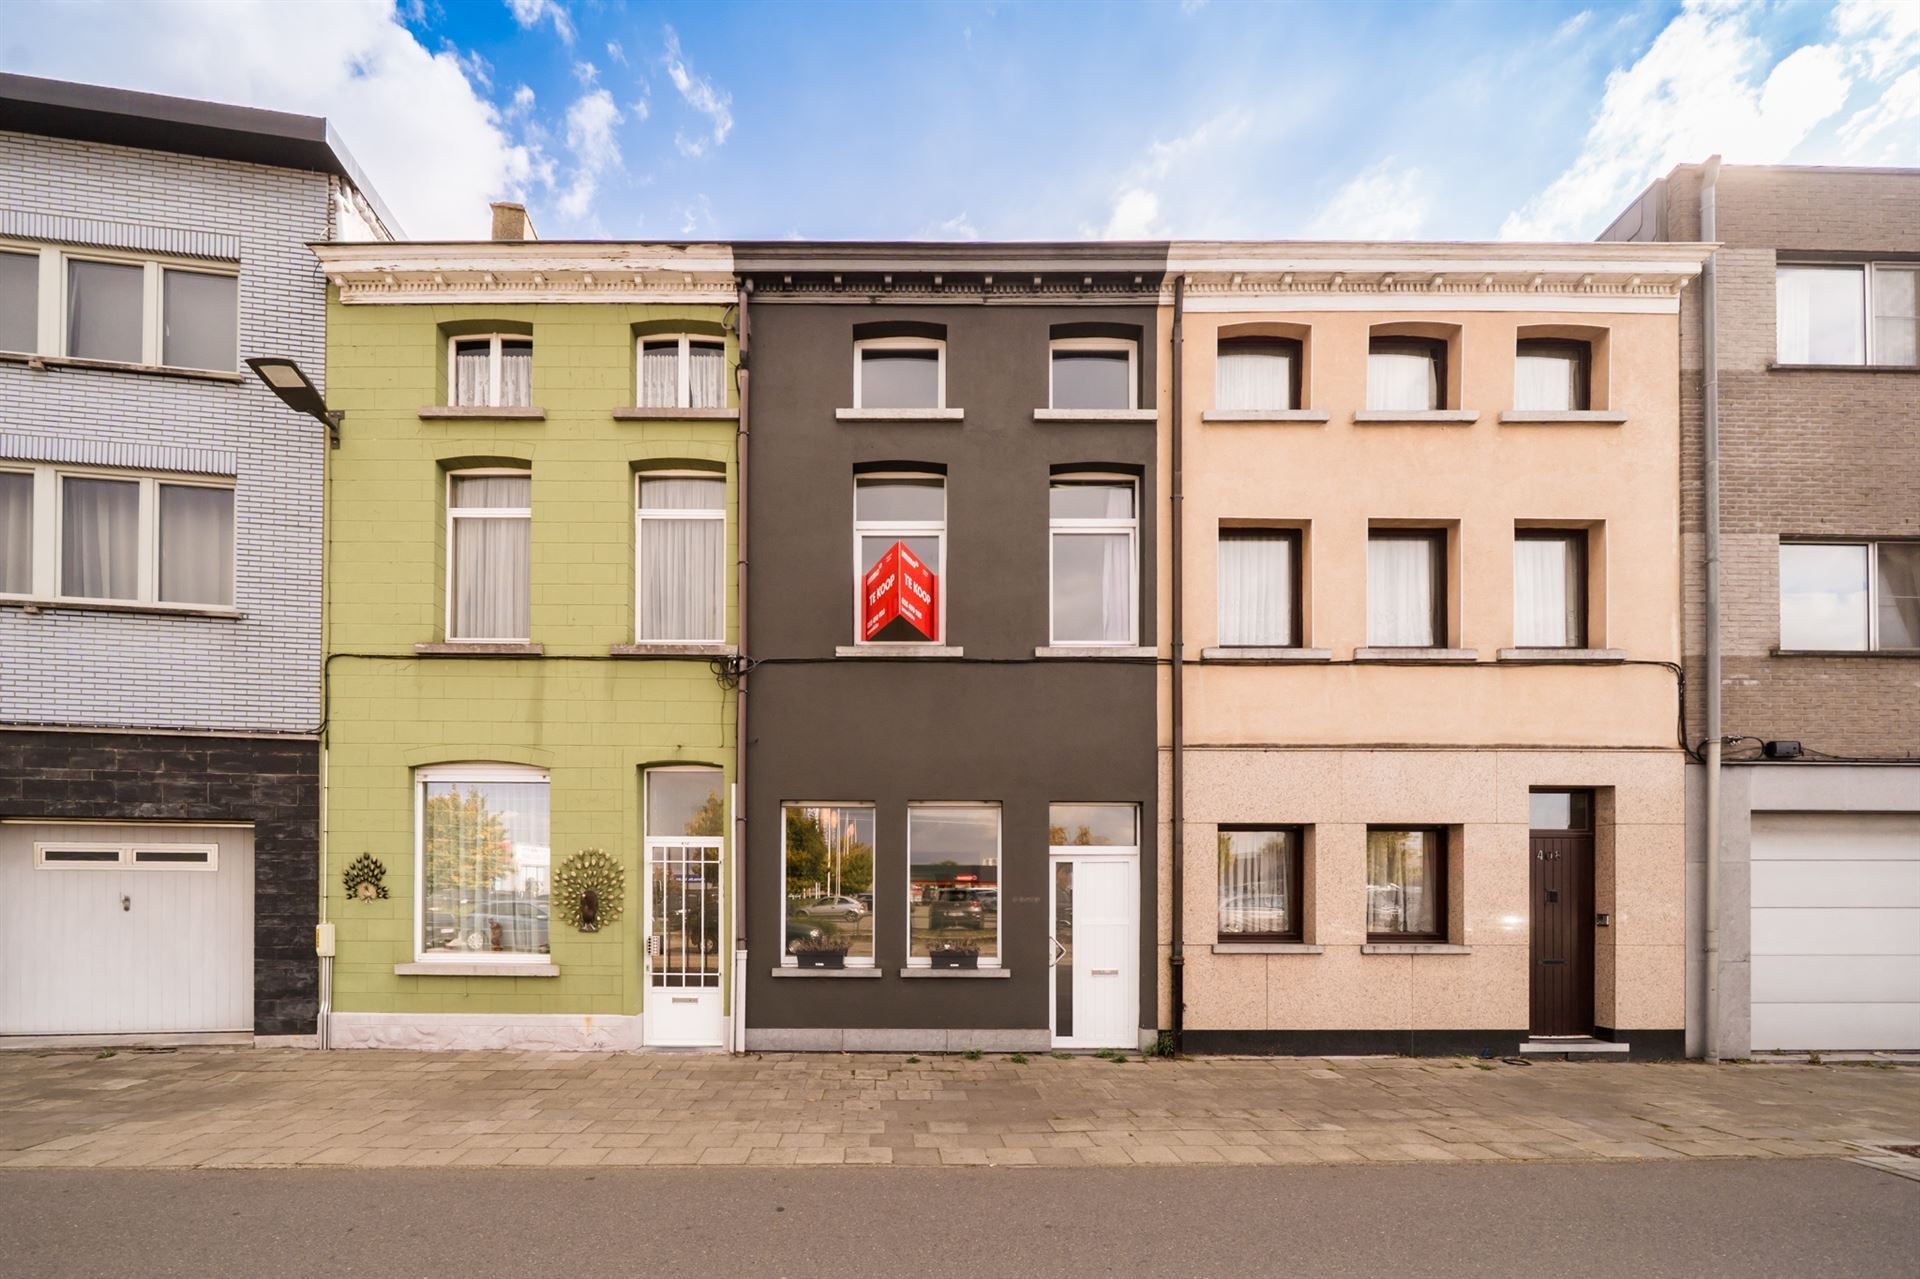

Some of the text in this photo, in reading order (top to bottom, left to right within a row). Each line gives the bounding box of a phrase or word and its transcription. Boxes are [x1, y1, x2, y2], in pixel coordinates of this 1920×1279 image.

[869, 574, 895, 606] TE KOOP
[904, 573, 913, 589] TE
[913, 581, 931, 605] KOOP
